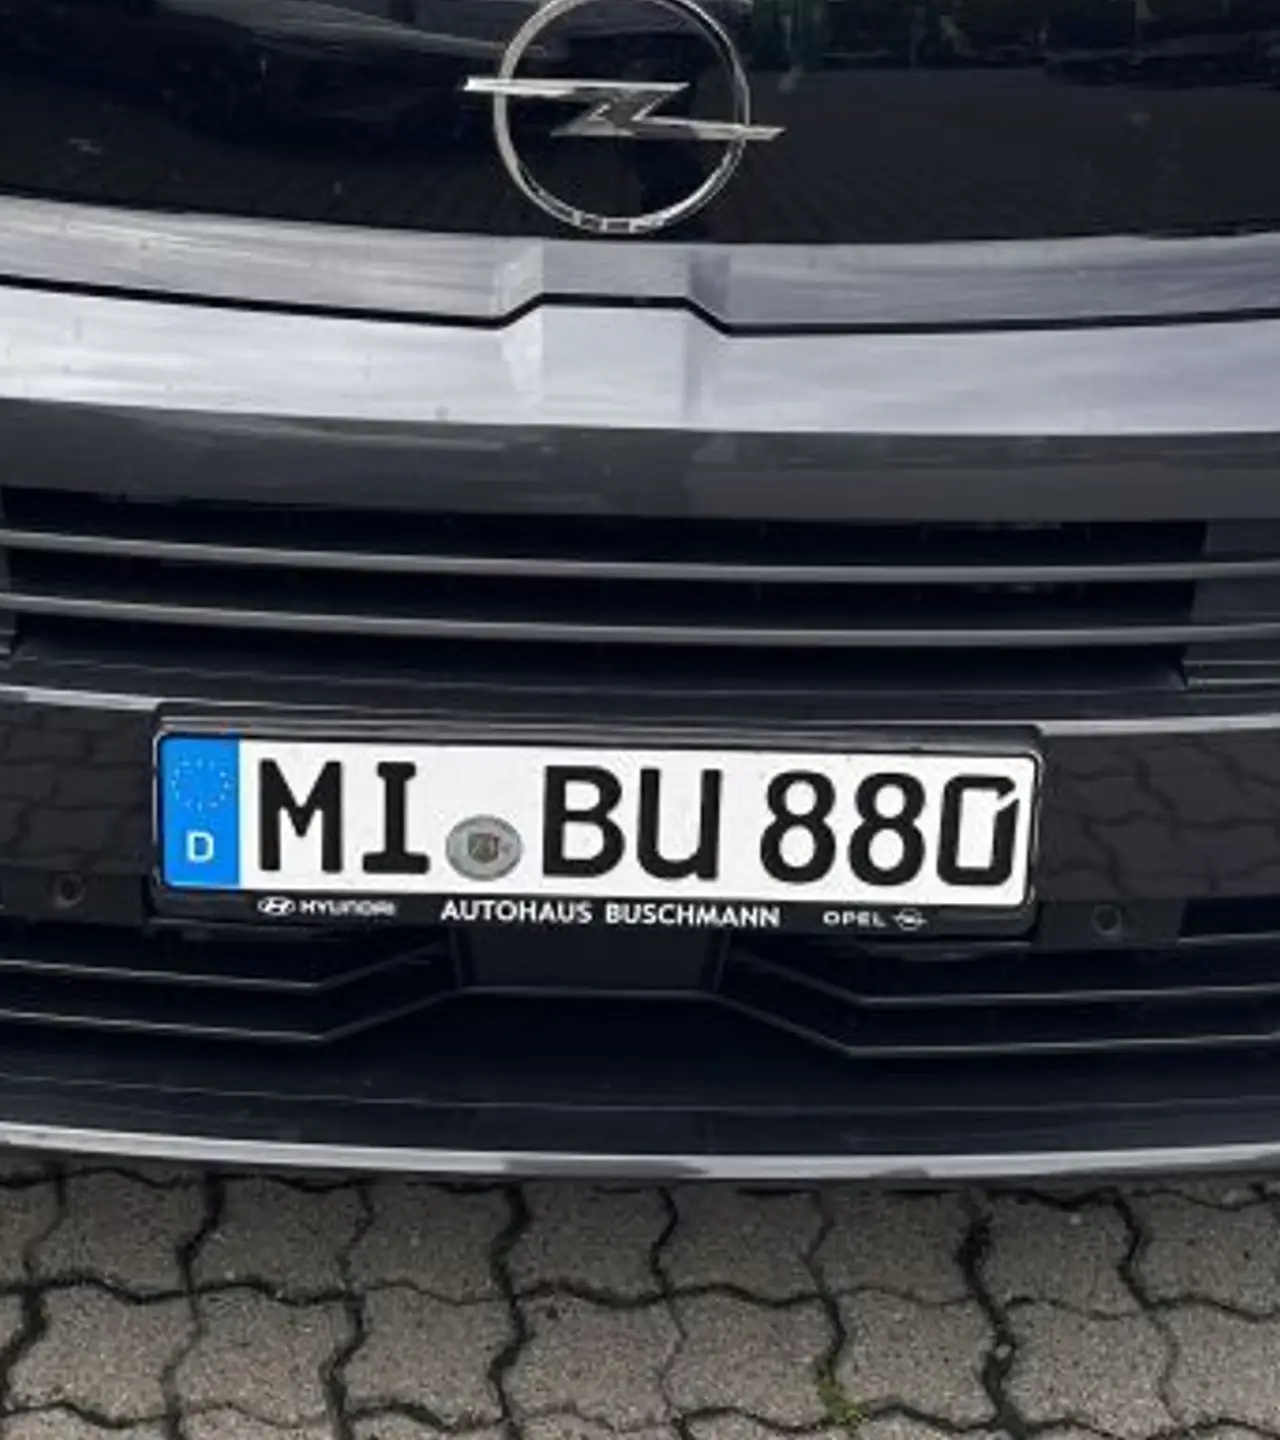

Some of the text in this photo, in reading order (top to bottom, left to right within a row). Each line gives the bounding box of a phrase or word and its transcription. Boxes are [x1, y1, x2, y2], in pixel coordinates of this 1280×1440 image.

[258, 758, 1021, 887] MI BU 880
[187, 829, 216, 863] D
[299, 899, 398, 917] HYUNDAI
[440, 898, 781, 928] AUTOHAUS BUSCHMANN
[822, 911, 886, 928] OPEL
